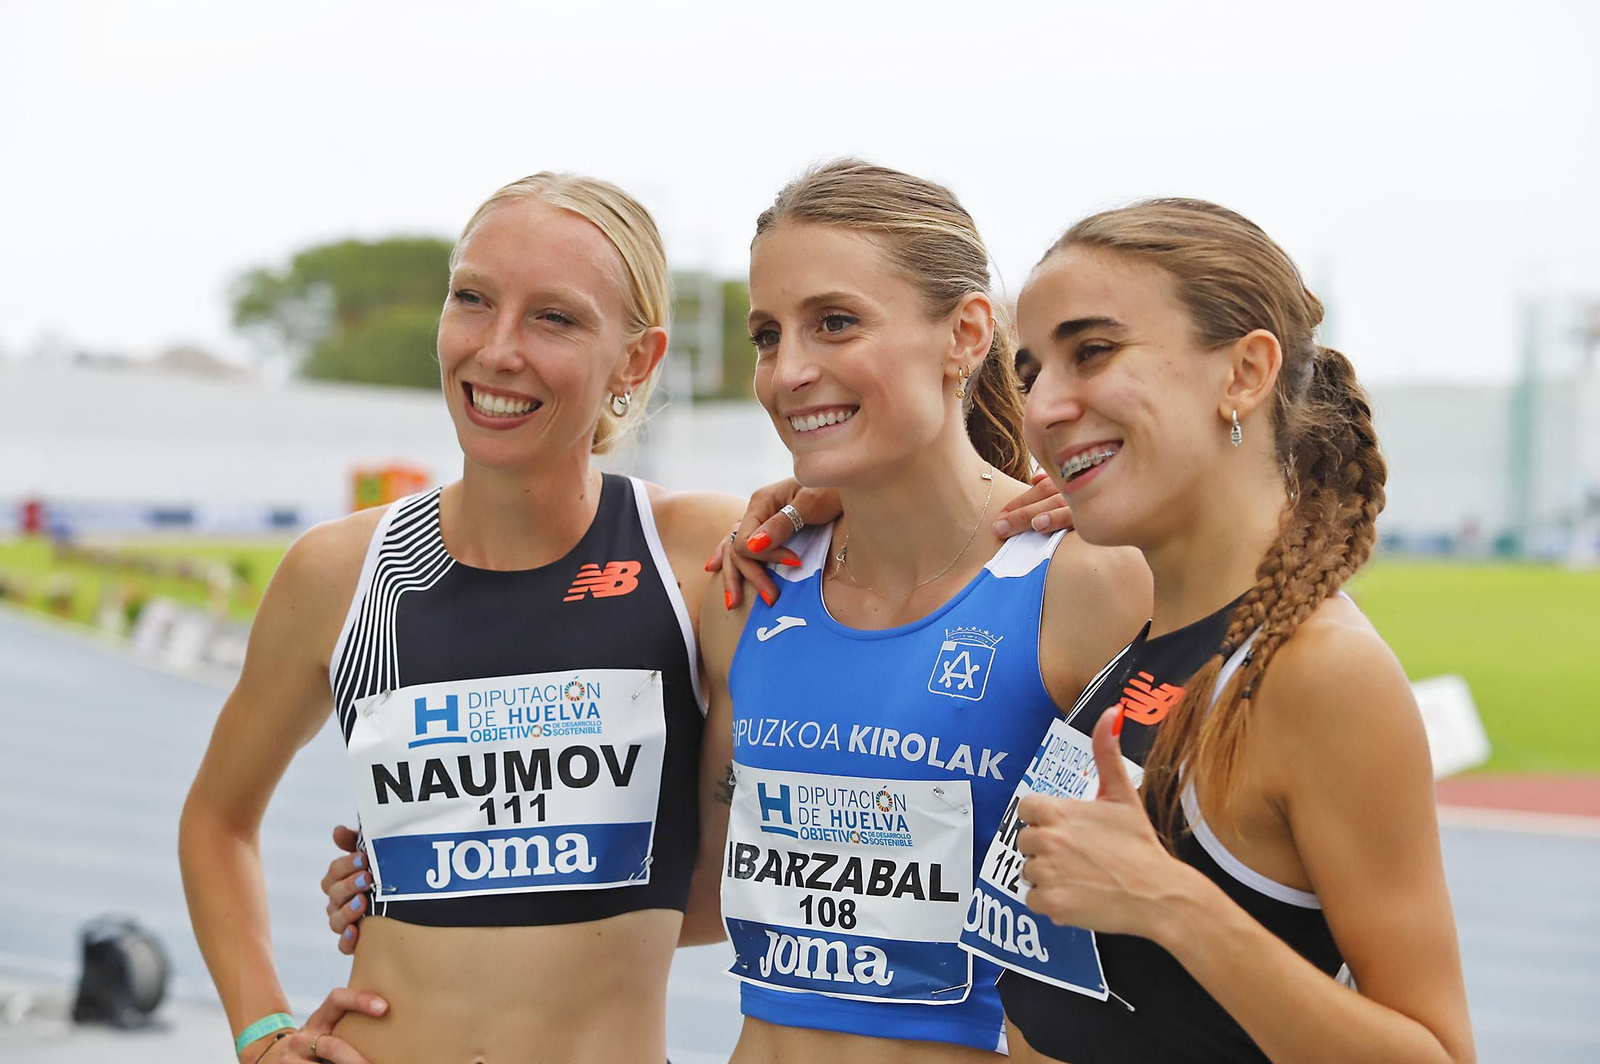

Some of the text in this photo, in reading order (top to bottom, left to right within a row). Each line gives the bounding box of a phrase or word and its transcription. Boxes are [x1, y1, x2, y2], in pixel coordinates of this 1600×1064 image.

[468, 676, 601, 709] DIPUTACIÓN
[469, 702, 601, 729] DE HUELVA
[562, 719, 602, 728] DESARROLLO
[470, 723, 552, 743] OBJETIVOS
[552, 726, 602, 736] SOSTENIBLE
[732, 718, 1009, 781] IPUZKOA KIROLAK
[371, 744, 642, 805] NAUMOV
[1039, 757, 1089, 799] DE HUELVA
[478, 793, 546, 825] 111
[798, 785, 907, 812] DIPUTACIÓN
[799, 807, 910, 832] DE HUELVA
[800, 826, 869, 845] OBJETIVOS
[869, 837, 913, 847] SOSTENIBLE
[875, 832, 912, 840] DESARROLLO
[727, 840, 960, 902] IBARZABAL
[992, 849, 1022, 894] 112
[799, 894, 857, 930] 108
